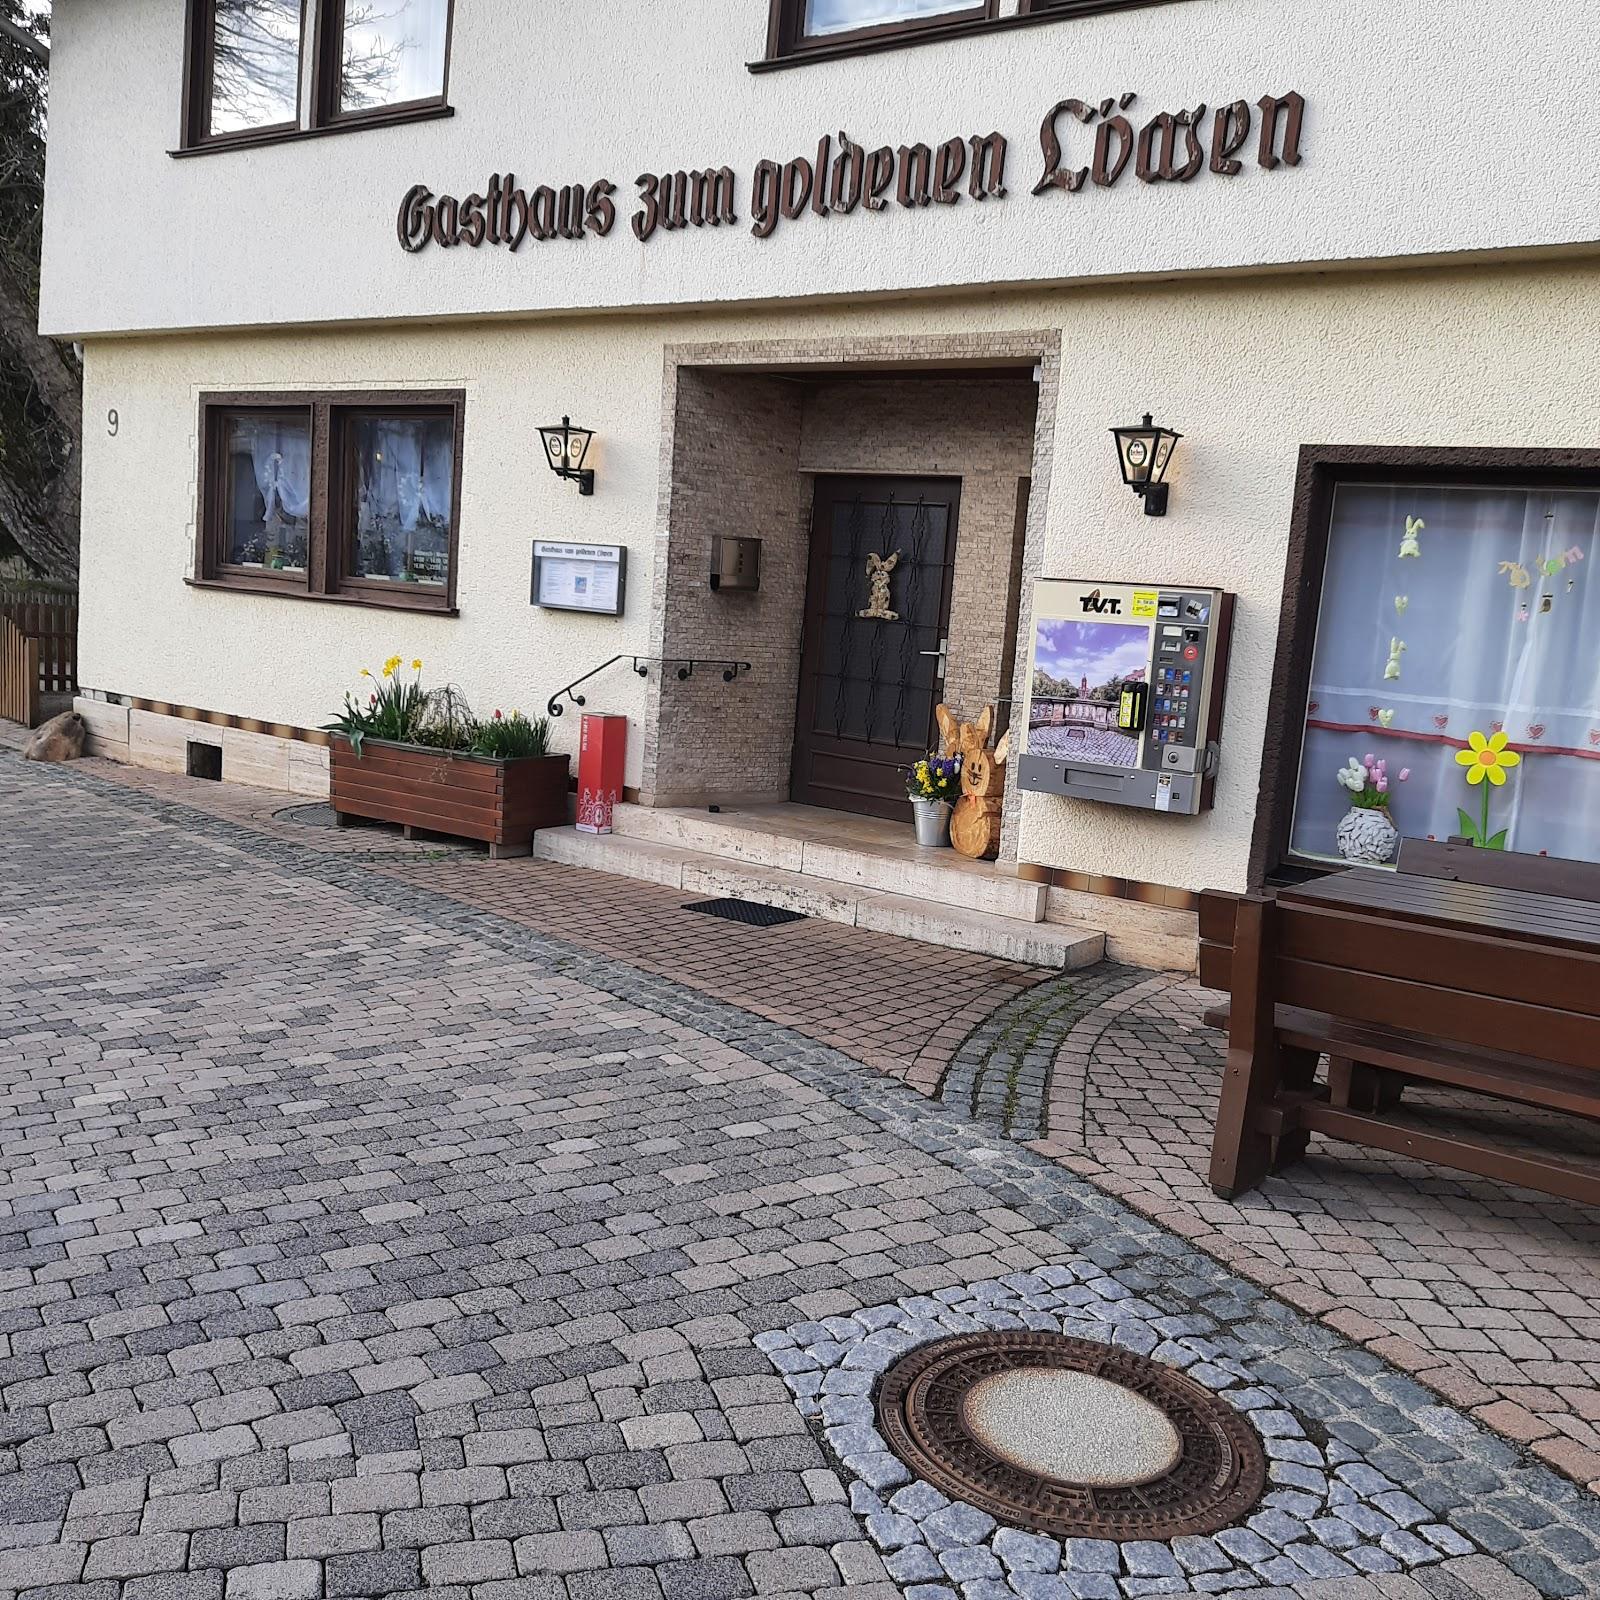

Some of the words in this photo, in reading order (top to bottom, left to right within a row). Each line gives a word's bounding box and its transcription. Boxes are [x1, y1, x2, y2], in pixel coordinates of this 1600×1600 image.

[396, 172, 617, 252] Gasthaus
[631, 166, 738, 242] zum
[750, 130, 1007, 238] goldenen
[107, 408, 118, 437] 9
